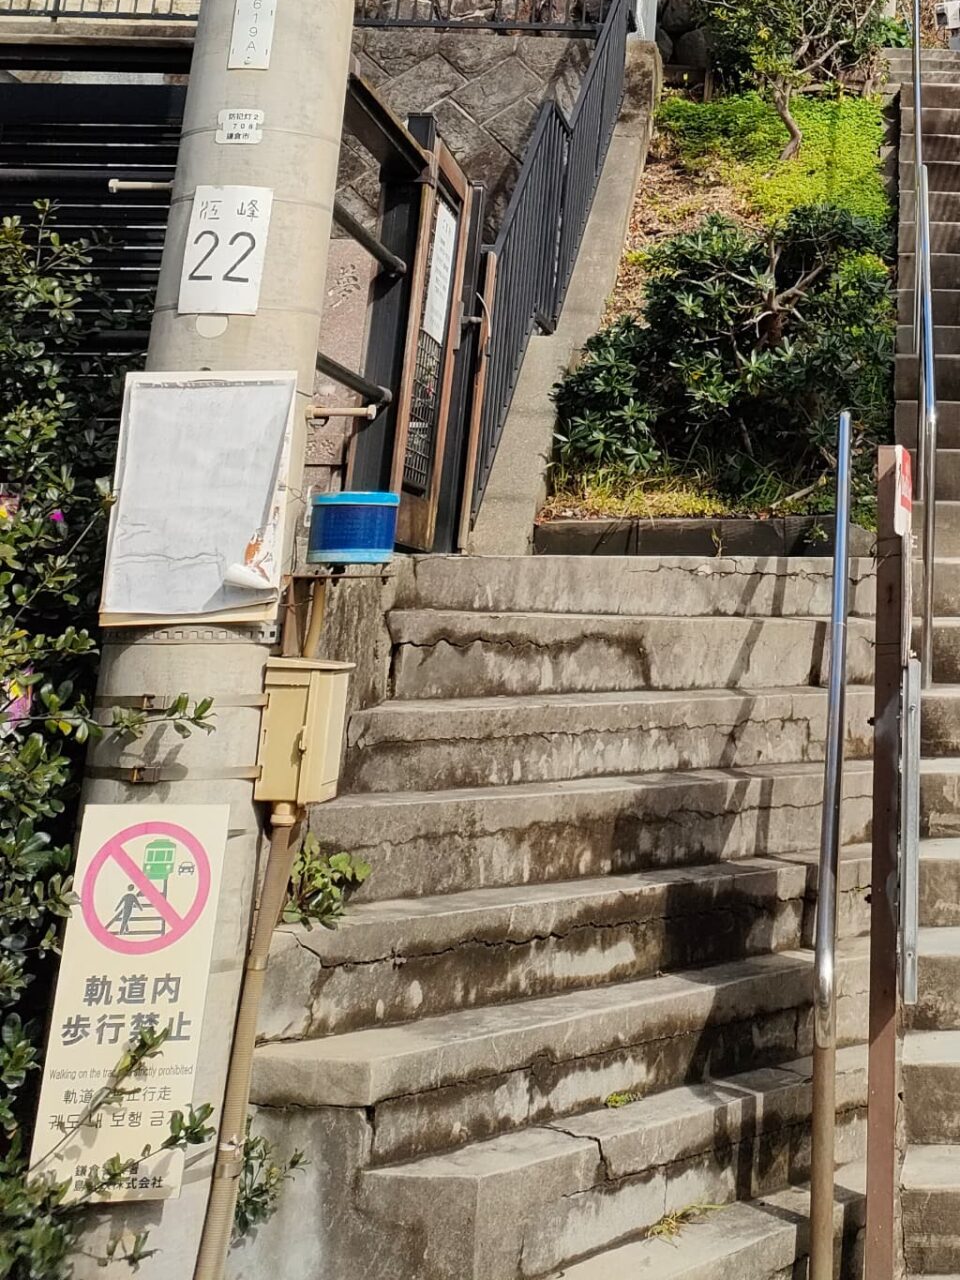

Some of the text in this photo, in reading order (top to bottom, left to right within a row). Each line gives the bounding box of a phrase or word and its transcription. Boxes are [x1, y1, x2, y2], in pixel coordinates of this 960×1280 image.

[188, 230, 256, 283] 22
[83, 973, 181, 1006] 軌道内
[61, 1011, 192, 1046] 歩行禁止
[50, 1069, 77, 1081] Walking
[78, 1070, 88, 1079] on
[90, 1067, 101, 1079] the
[158, 1063, 193, 1077] prohibited
[110, 1111, 142, 1128] 보행
